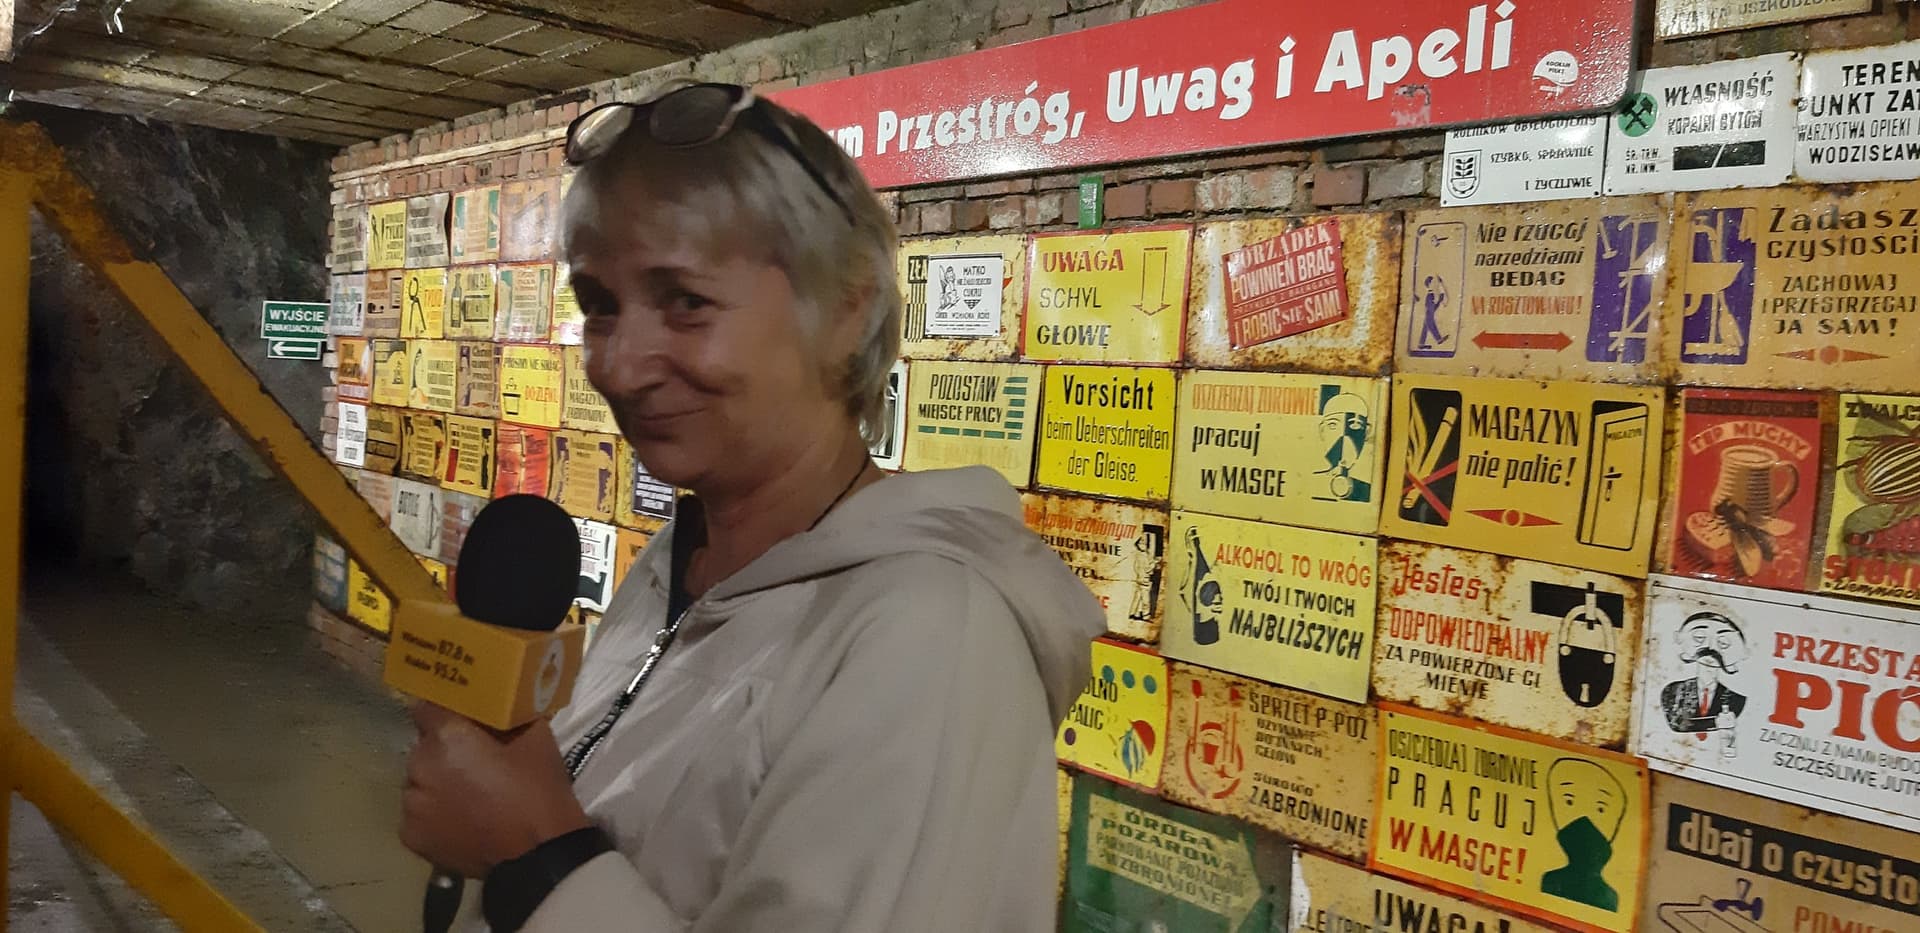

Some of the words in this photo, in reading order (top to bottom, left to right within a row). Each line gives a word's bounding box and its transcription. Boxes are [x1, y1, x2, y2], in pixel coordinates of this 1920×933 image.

[876, 80, 1085, 155] Przestróg,
[1106, 58, 1255, 123] Uwag
[1276, 36, 1297, 99] i
[1314, 2, 1516, 100] Apeli
[1664, 71, 1774, 108] WŁASNOŚĆ
[1841, 60, 1920, 87] TEREN
[1798, 92, 1875, 118] PUNKT
[1667, 116, 1716, 136] KOPALNI
[1870, 117, 1911, 138] OPIEKI
[1537, 146, 1595, 161] SPRAWNIE
[1534, 176, 1593, 190] ŻYCZLIWIE
[1476, 222, 1507, 244] Nie
[1513, 217, 1589, 243] rzucaj
[1042, 248, 1125, 273] UWAGA
[1039, 287, 1102, 309] SCHYL
[1231, 260, 1296, 304] POWINIEN
[1782, 274, 1898, 293] ZACHOWAJ
[269, 308, 325, 322] WYJŚCIE
[1772, 296, 1917, 314] PRZESTRZEGAJ
[1774, 319, 1802, 335] JA
[929, 374, 1000, 403] POZOSTAW
[1063, 374, 1154, 411] Vorsicht
[918, 404, 963, 421] MIEJSCE
[965, 405, 1003, 424] PRACY
[1468, 404, 1581, 447] MAGAZYN
[1047, 414, 1072, 440] beim
[1075, 416, 1169, 450] Ueberschreiten
[1192, 423, 1261, 457] pracuj
[1733, 422, 1808, 457] MUCHY
[1067, 453, 1090, 476] der
[1095, 451, 1138, 483] Gleise.
[1466, 450, 1500, 478] nie
[1220, 466, 1287, 498] MASCE
[1215, 543, 1284, 574] ALKOHOL
[1292, 554, 1311, 578] TO
[1319, 555, 1371, 588] WRÓG
[1243, 579, 1281, 604] TWÓJ
[1285, 588, 1291, 606] I
[1294, 589, 1355, 618] TWOICH
[1228, 607, 1364, 660] NAJBLIŻSZYCH
[1385, 644, 1403, 662] ZA
[1409, 649, 1516, 684] POWIERZONE
[1426, 672, 1489, 700] MIENIE
[1821, 741, 1833, 756] Z
[1835, 744, 1877, 763] NAMI
[1773, 751, 1878, 788] SZCZĘŚLIWE
[1249, 786, 1369, 840] ZABRONIONE
[1387, 766, 1537, 836] PRACUJ
[1124, 810, 1215, 851] DROGA
[1679, 812, 1754, 870] dbaj
[1762, 842, 1784, 873] o
[1389, 817, 1415, 852] W
[1419, 826, 1528, 885] MASCE!
